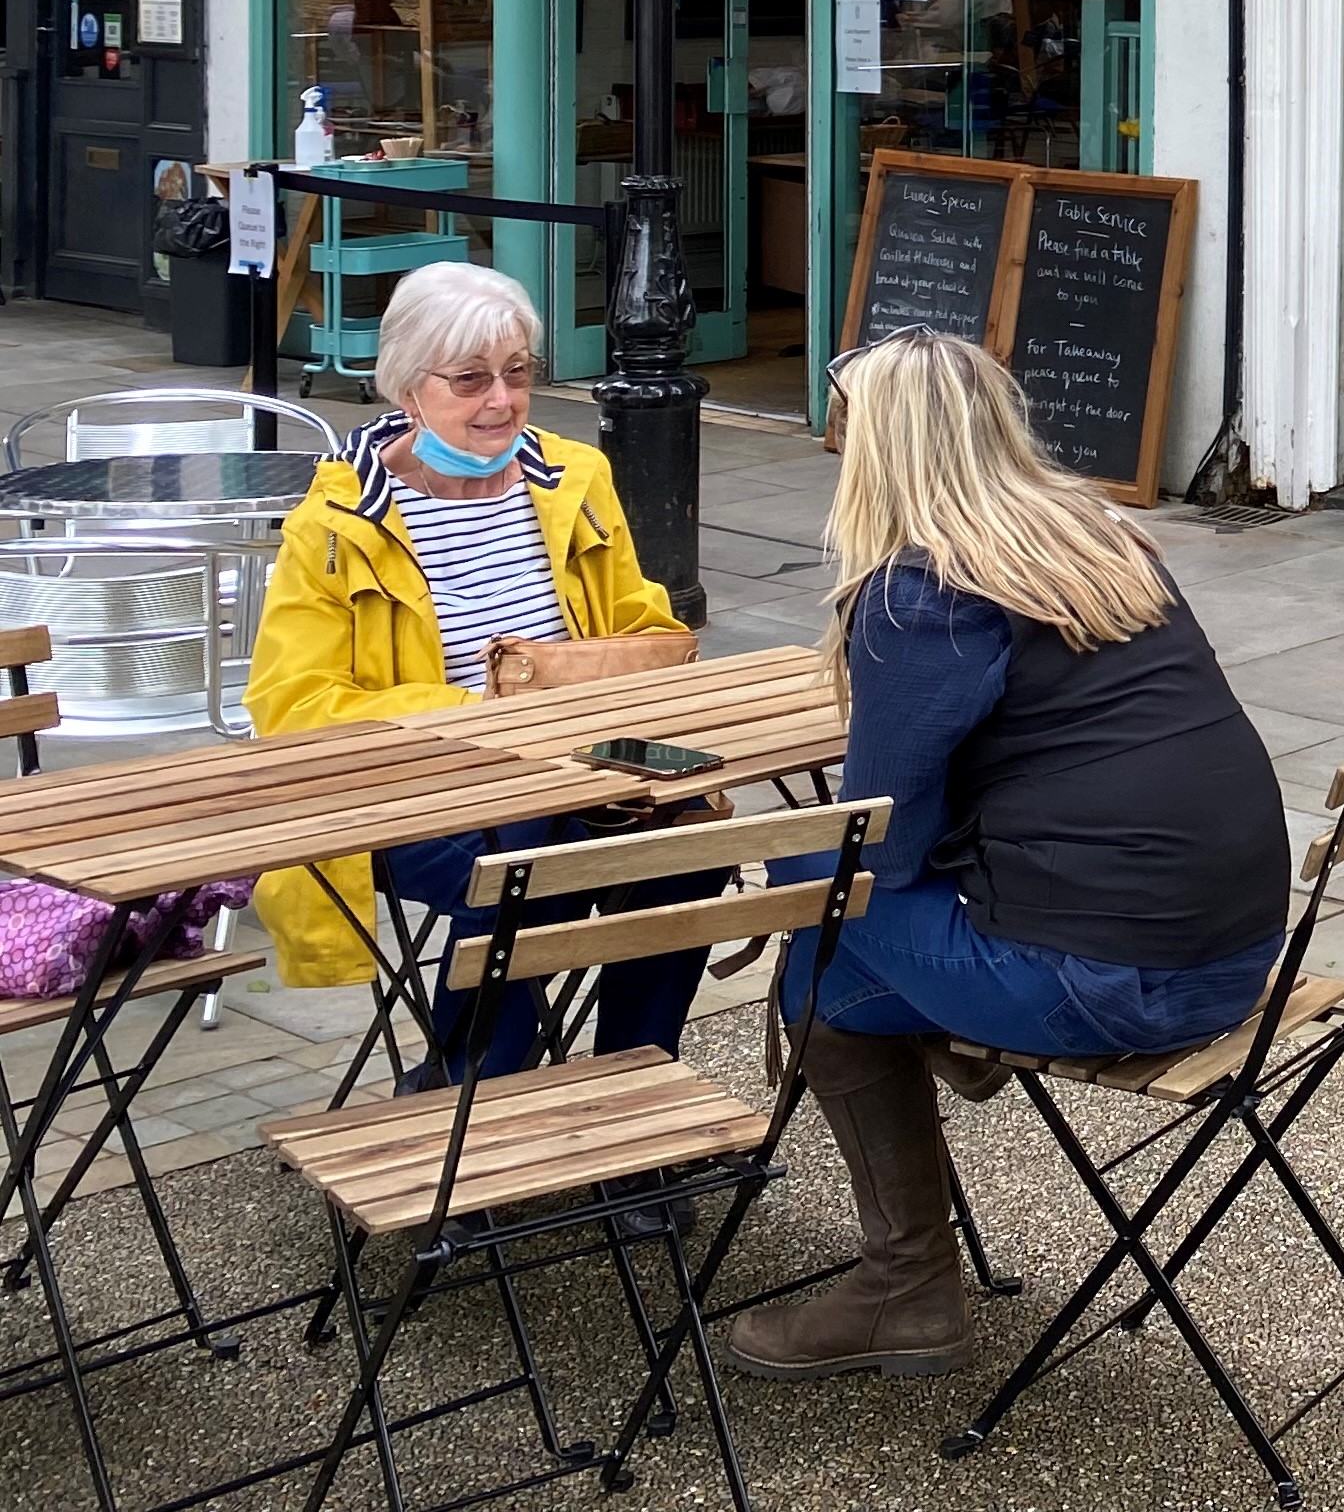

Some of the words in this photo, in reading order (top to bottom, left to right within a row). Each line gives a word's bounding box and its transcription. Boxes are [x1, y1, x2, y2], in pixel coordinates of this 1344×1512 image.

[904, 184, 935, 203] Lunch
[941, 190, 982, 213] Special
[1057, 199, 1092, 224] Table
[1097, 206, 1147, 237] Service
[1038, 230, 1070, 256] Please
[1074, 240, 1098, 261] find
[1101, 248, 1110, 261] a
[1037, 265, 1059, 279] and
[1113, 274, 1144, 291] come
[1057, 288, 1069, 300] to
[1075, 295, 1099, 311] you
[1027, 338, 1048, 355] For
[1062, 371, 1101, 389] queue
[1108, 373, 1120, 388] to
[1070, 400, 1082, 417] of
[1106, 407, 1132, 422] door
[1073, 445, 1097, 464] you
